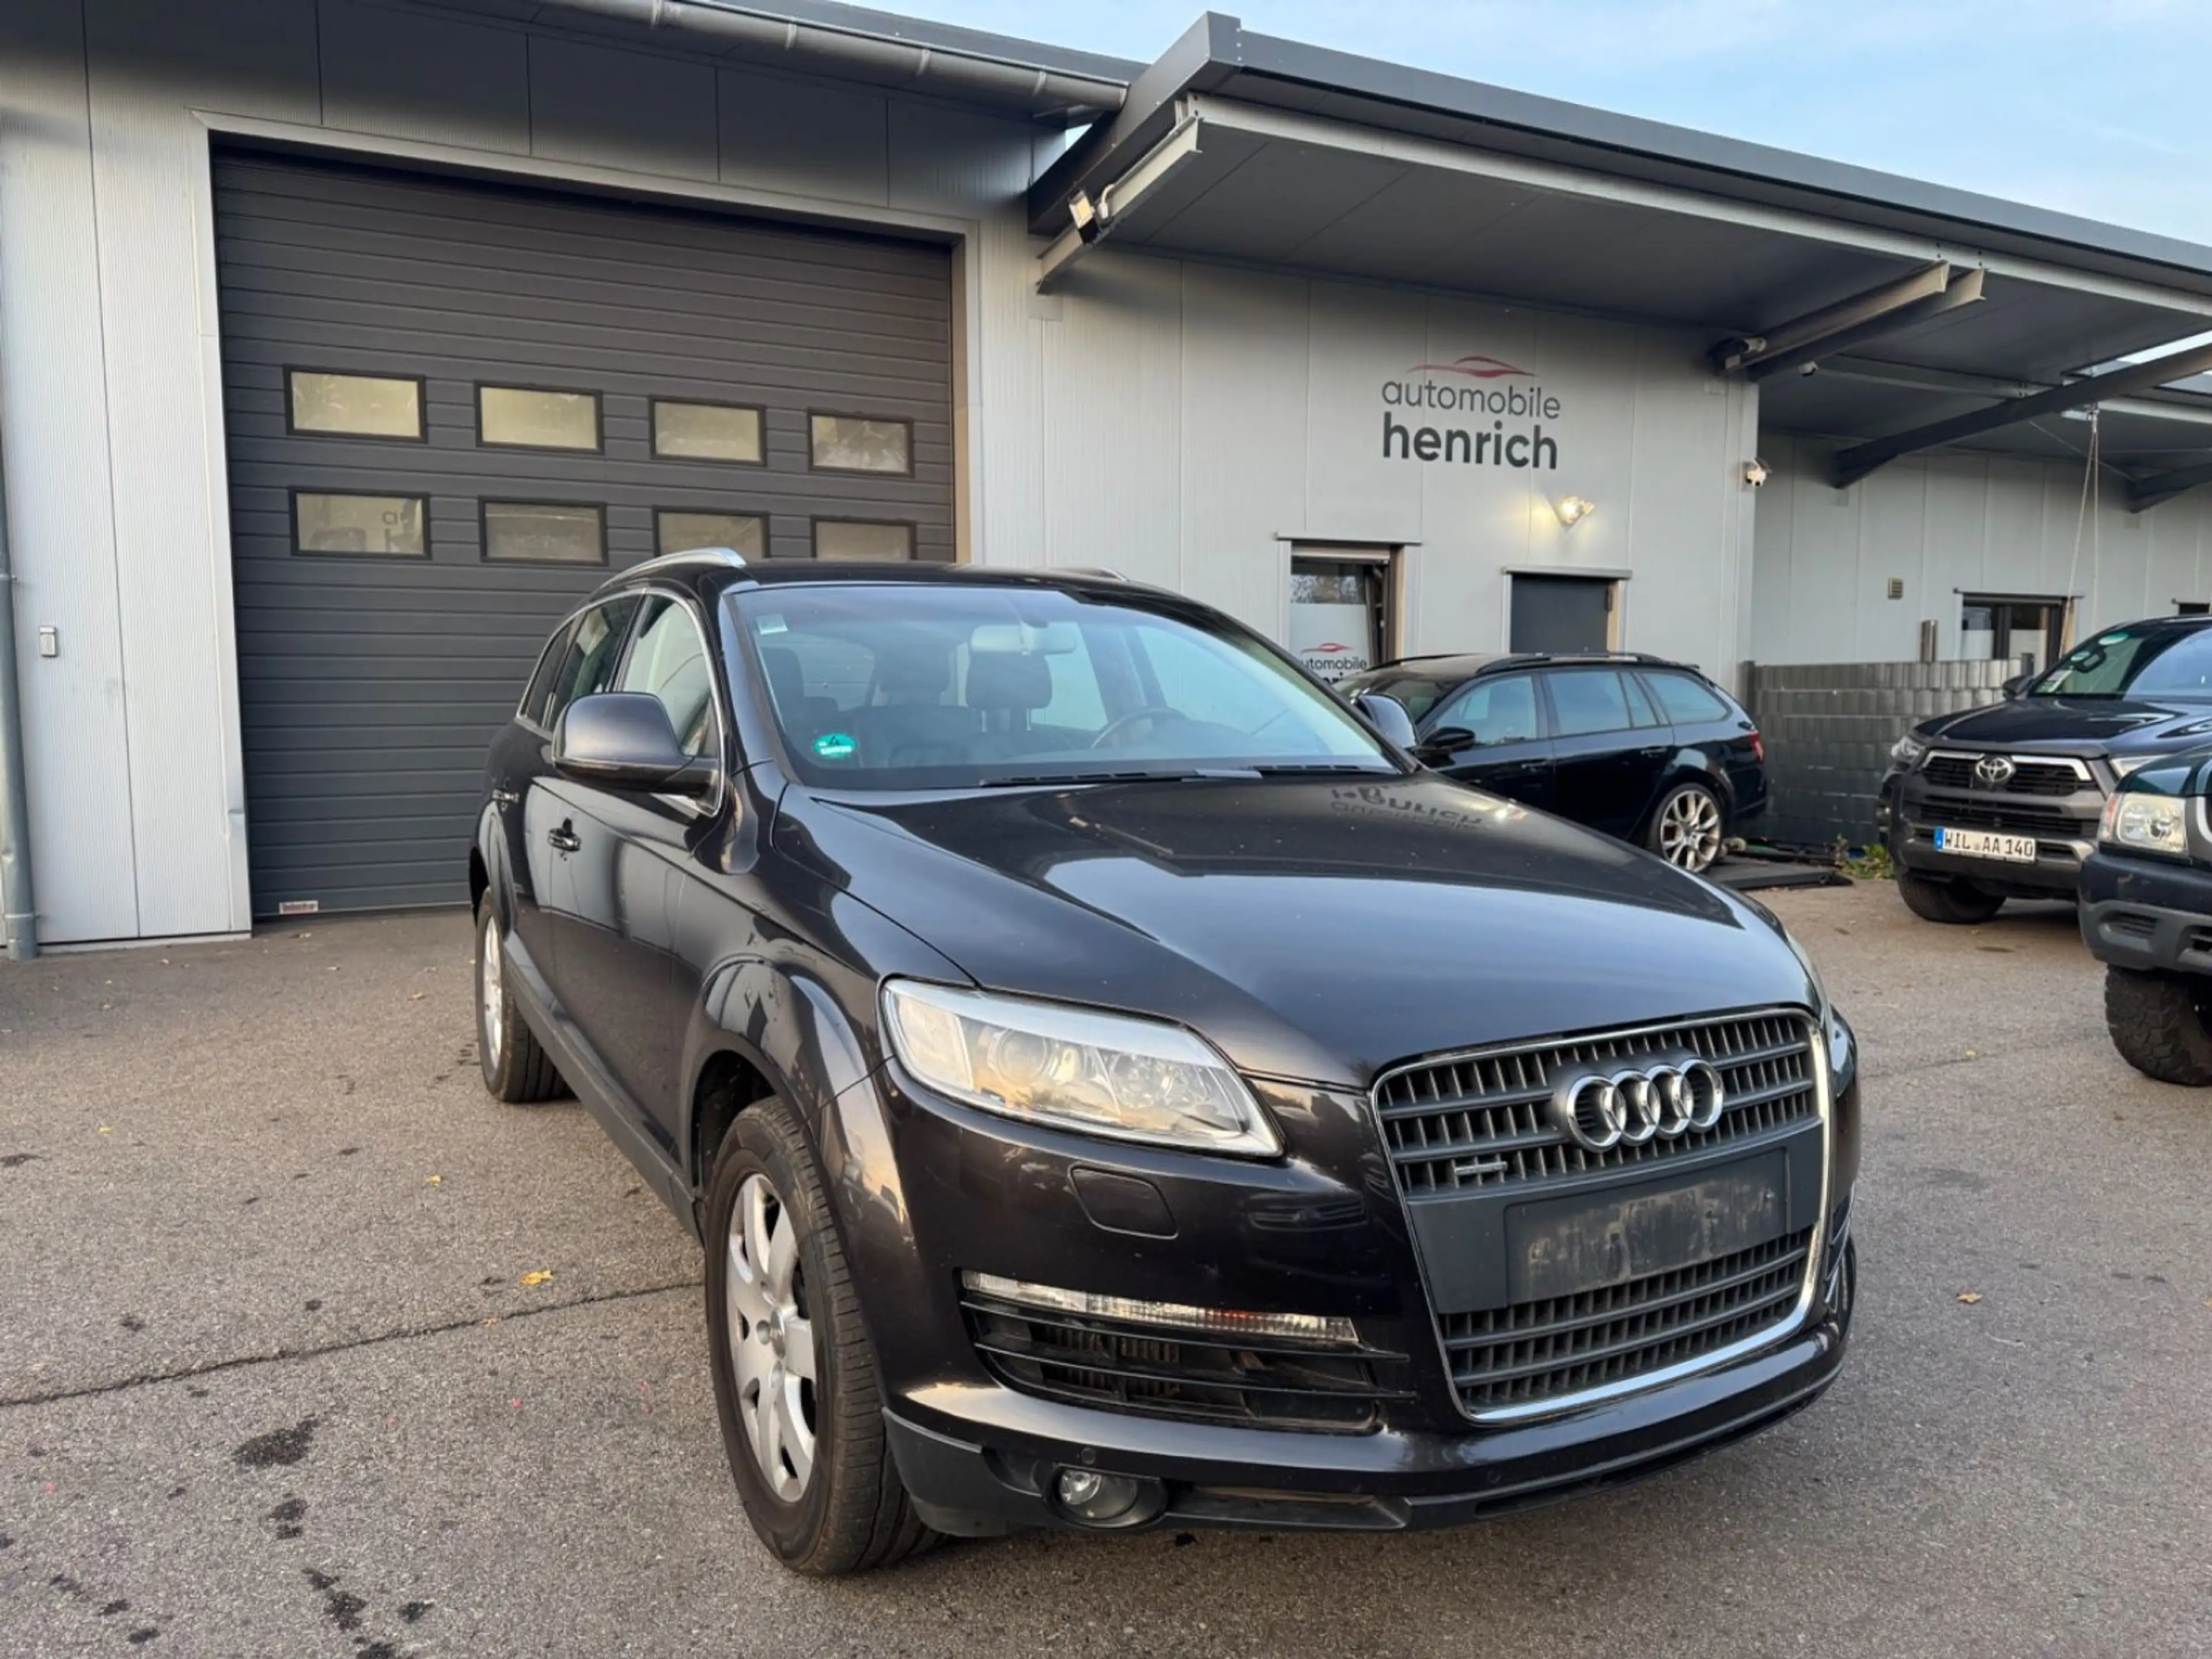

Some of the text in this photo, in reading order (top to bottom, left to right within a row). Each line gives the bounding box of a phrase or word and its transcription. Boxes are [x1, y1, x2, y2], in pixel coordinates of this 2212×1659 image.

[1382, 380, 1560, 419] automobile
[1383, 411, 1558, 469] henrich
[1301, 656, 1368, 671] utomobile
[1945, 831, 2034, 857] WIL AA 140
